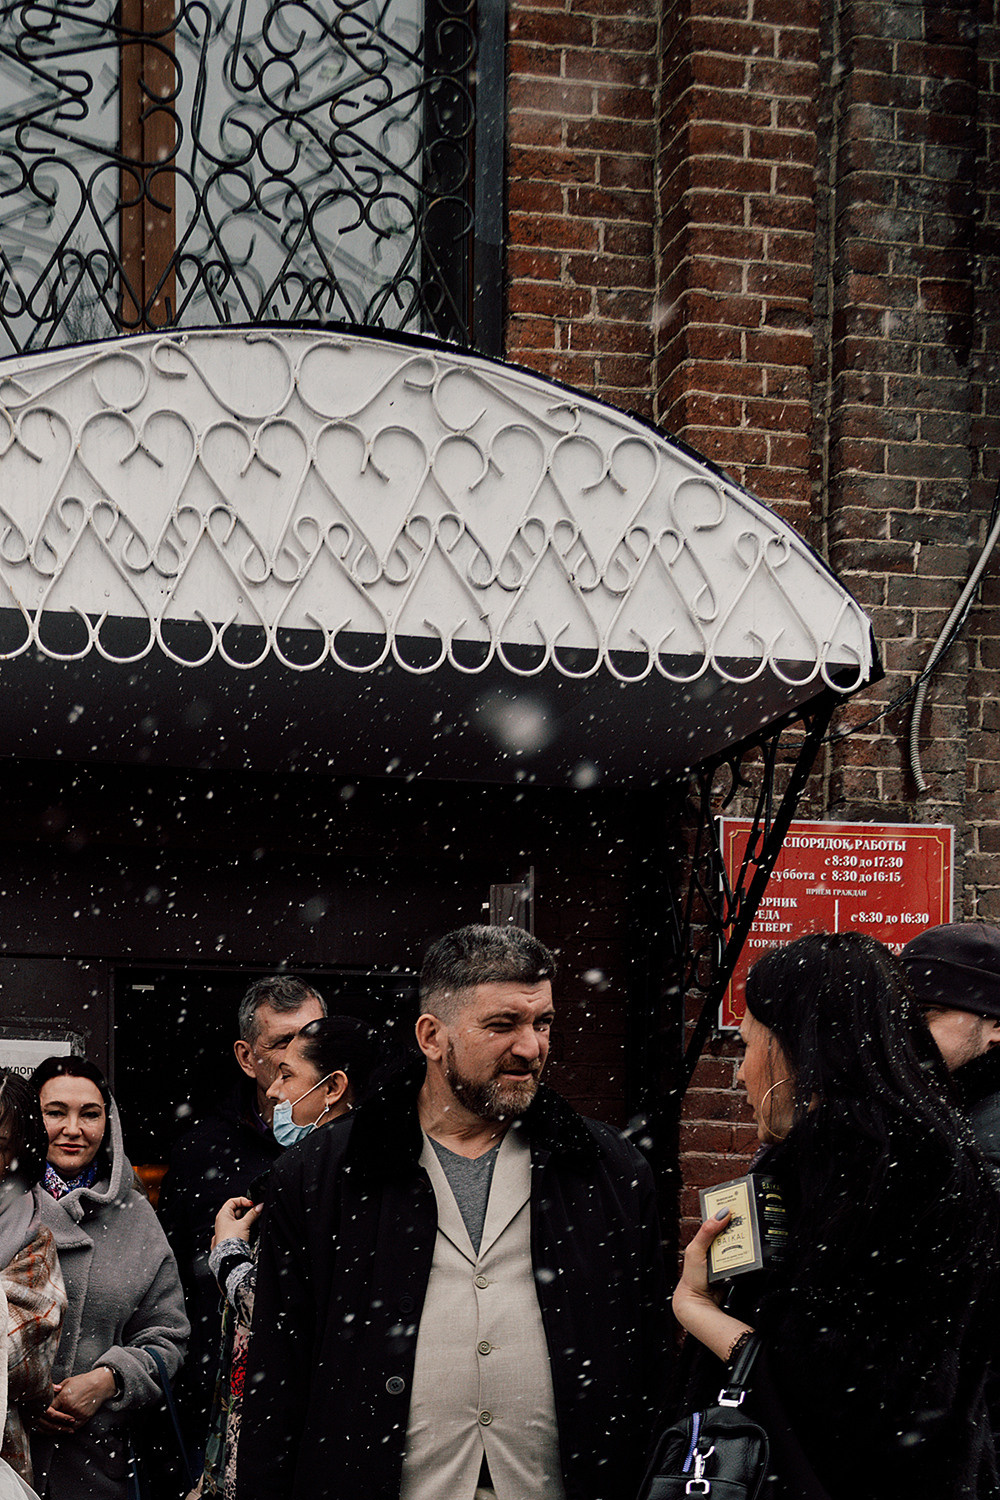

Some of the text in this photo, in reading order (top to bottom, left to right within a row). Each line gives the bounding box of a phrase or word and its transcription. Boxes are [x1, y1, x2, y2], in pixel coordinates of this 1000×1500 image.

[781, 836, 907, 852] СПОРЯДОК РАБОТЫ
[770, 869, 816, 883] суббота
[820, 873, 827, 881] с
[831, 870, 858, 882] 8:30
[832, 889, 867, 897] ГРАЖДАН
[758, 897, 798, 908] ОРНИК
[858, 912, 883, 923] 8:30
[885, 914, 898, 924] до
[900, 912, 930, 924] 16:30
[748, 922, 793, 933] ЕТВЕРГ
[716, 1232, 746, 1246] BAIKAL
